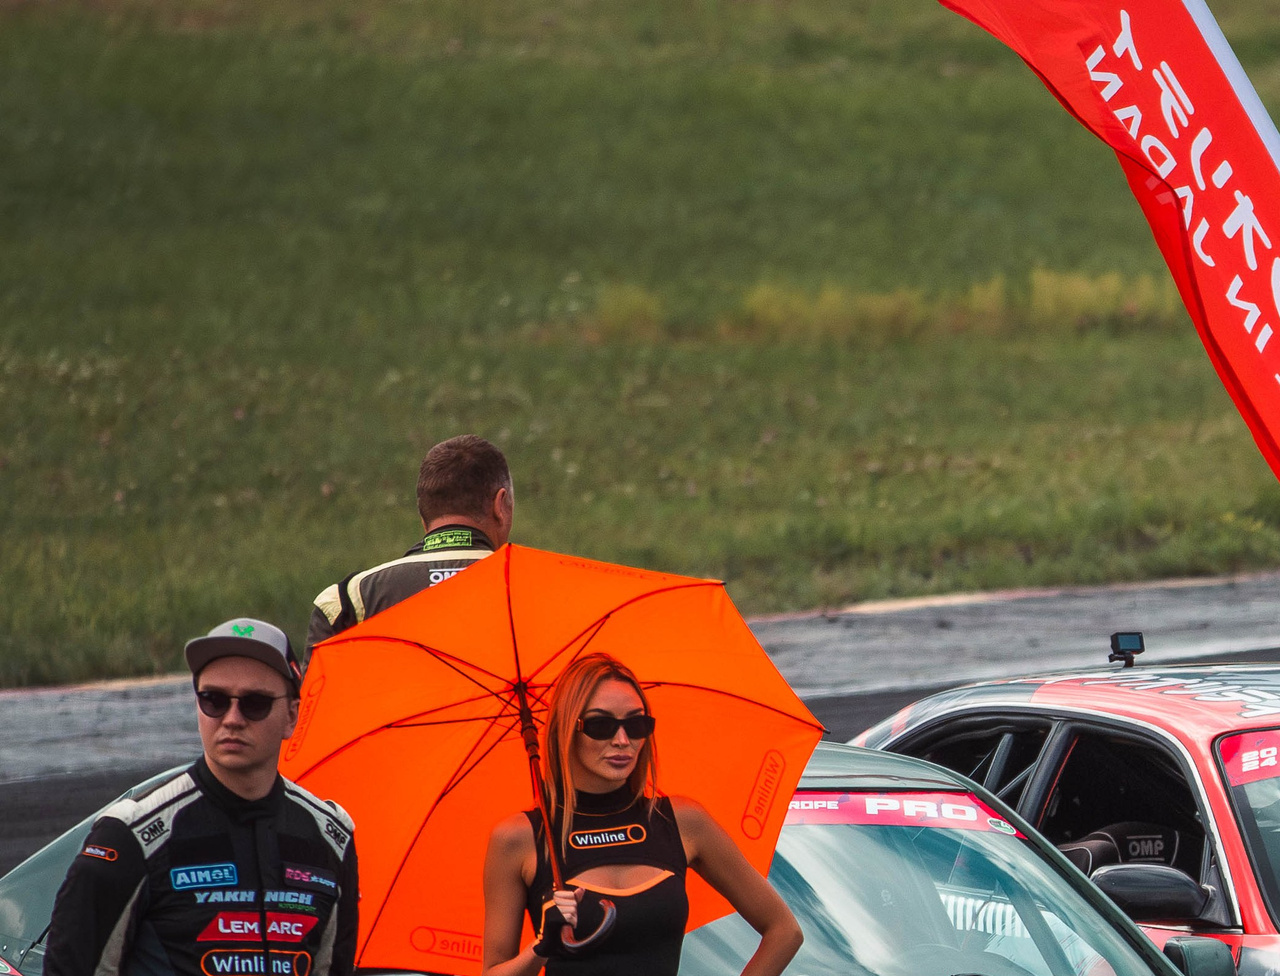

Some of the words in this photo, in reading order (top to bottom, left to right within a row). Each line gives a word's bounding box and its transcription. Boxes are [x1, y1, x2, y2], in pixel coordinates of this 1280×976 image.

[1241, 746, 1278, 762] 20
[1242, 757, 1278, 772] 24
[865, 797, 978, 821] PRO
[140, 820, 166, 844] OMP
[325, 822, 347, 845] OMP
[575, 830, 626, 846] Winline
[1129, 840, 1164, 856] OMP
[176, 867, 234, 885] AIMOL
[212, 954, 292, 975] Winline
